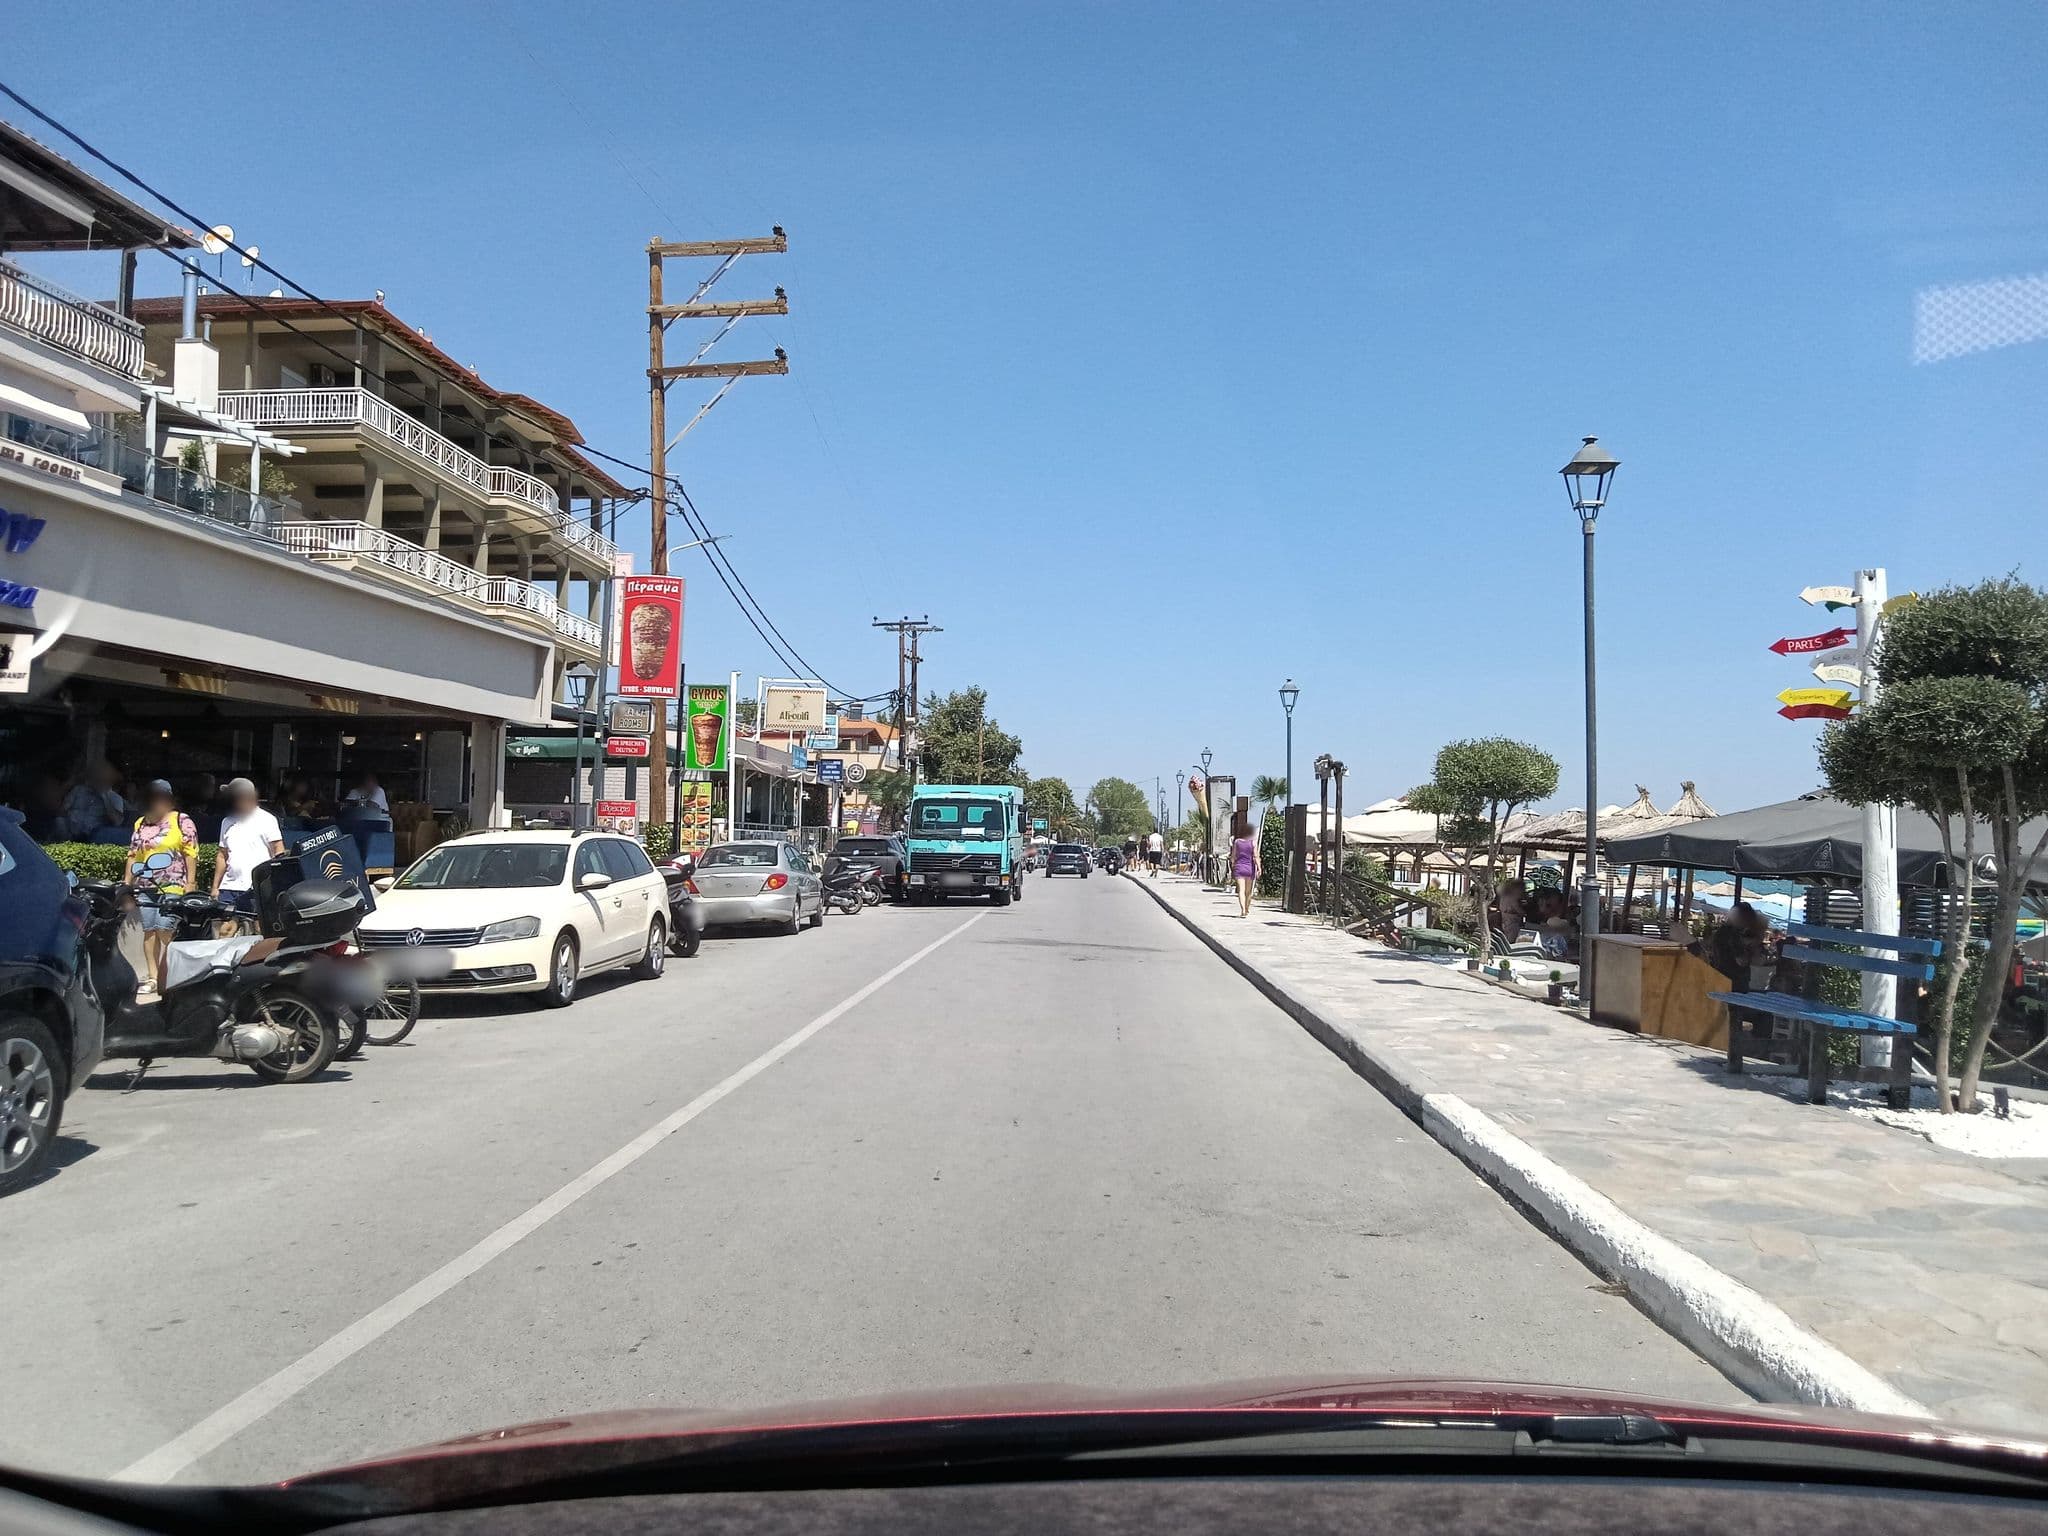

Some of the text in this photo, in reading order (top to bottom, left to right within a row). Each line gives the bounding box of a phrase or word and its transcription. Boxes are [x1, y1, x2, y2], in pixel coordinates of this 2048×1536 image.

[33, 457, 81, 480] rooms
[627, 581, 679, 594] Πέρασμα
[1787, 637, 1823, 651] PARIS
[691, 688, 725, 701] GYROS
[619, 718, 642, 728] ROOMS
